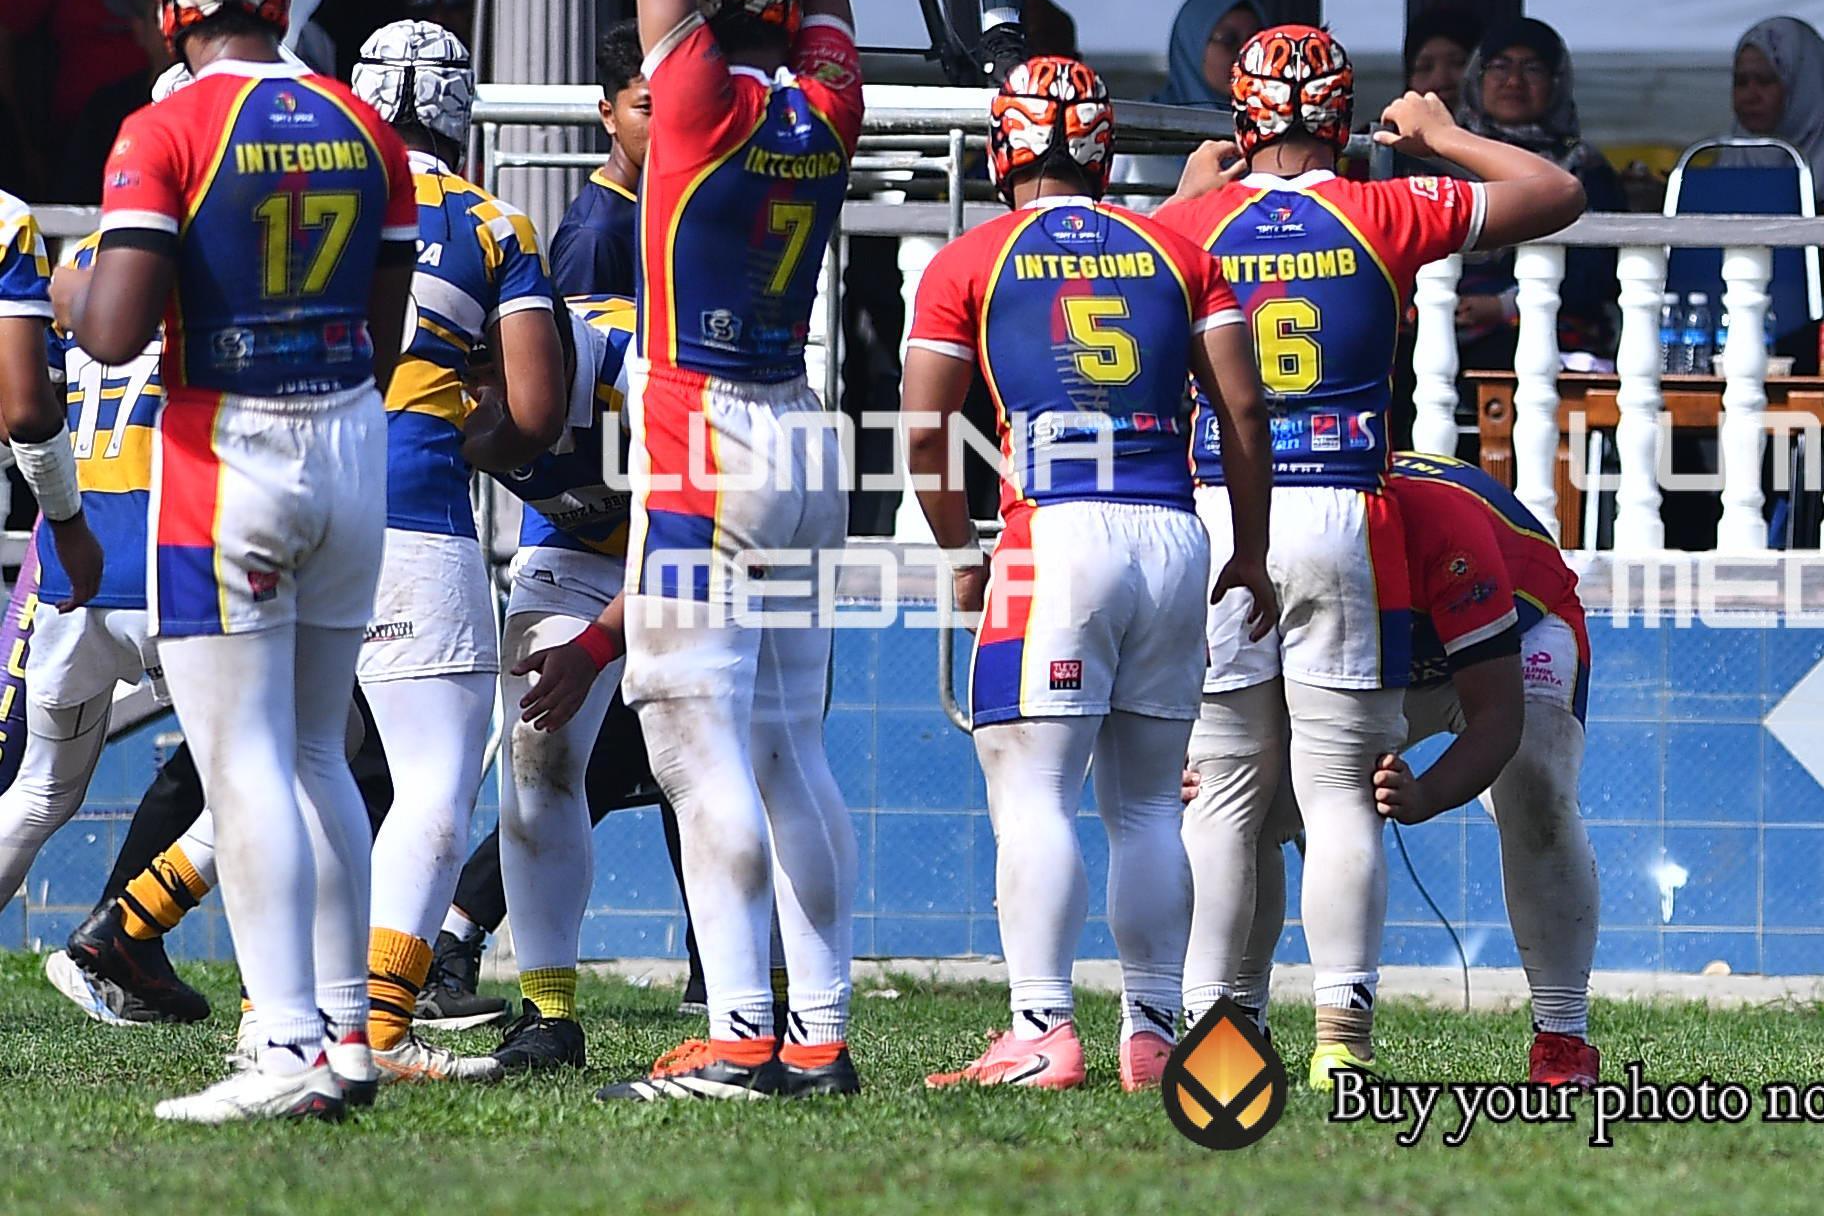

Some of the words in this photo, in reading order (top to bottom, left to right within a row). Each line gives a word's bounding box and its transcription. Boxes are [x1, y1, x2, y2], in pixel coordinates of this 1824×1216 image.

[235, 139, 369, 176] INTEGOMB
[744, 145, 841, 179] INTEGOMB
[253, 190, 363, 300] 17
[765, 201, 817, 295] 7
[1014, 251, 1156, 281] INTEGOMB
[1222, 247, 1357, 283] NTEGOMB
[1061, 296, 1142, 385] 5
[1252, 297, 1321, 395] 6
[73, 354, 161, 459] 17
